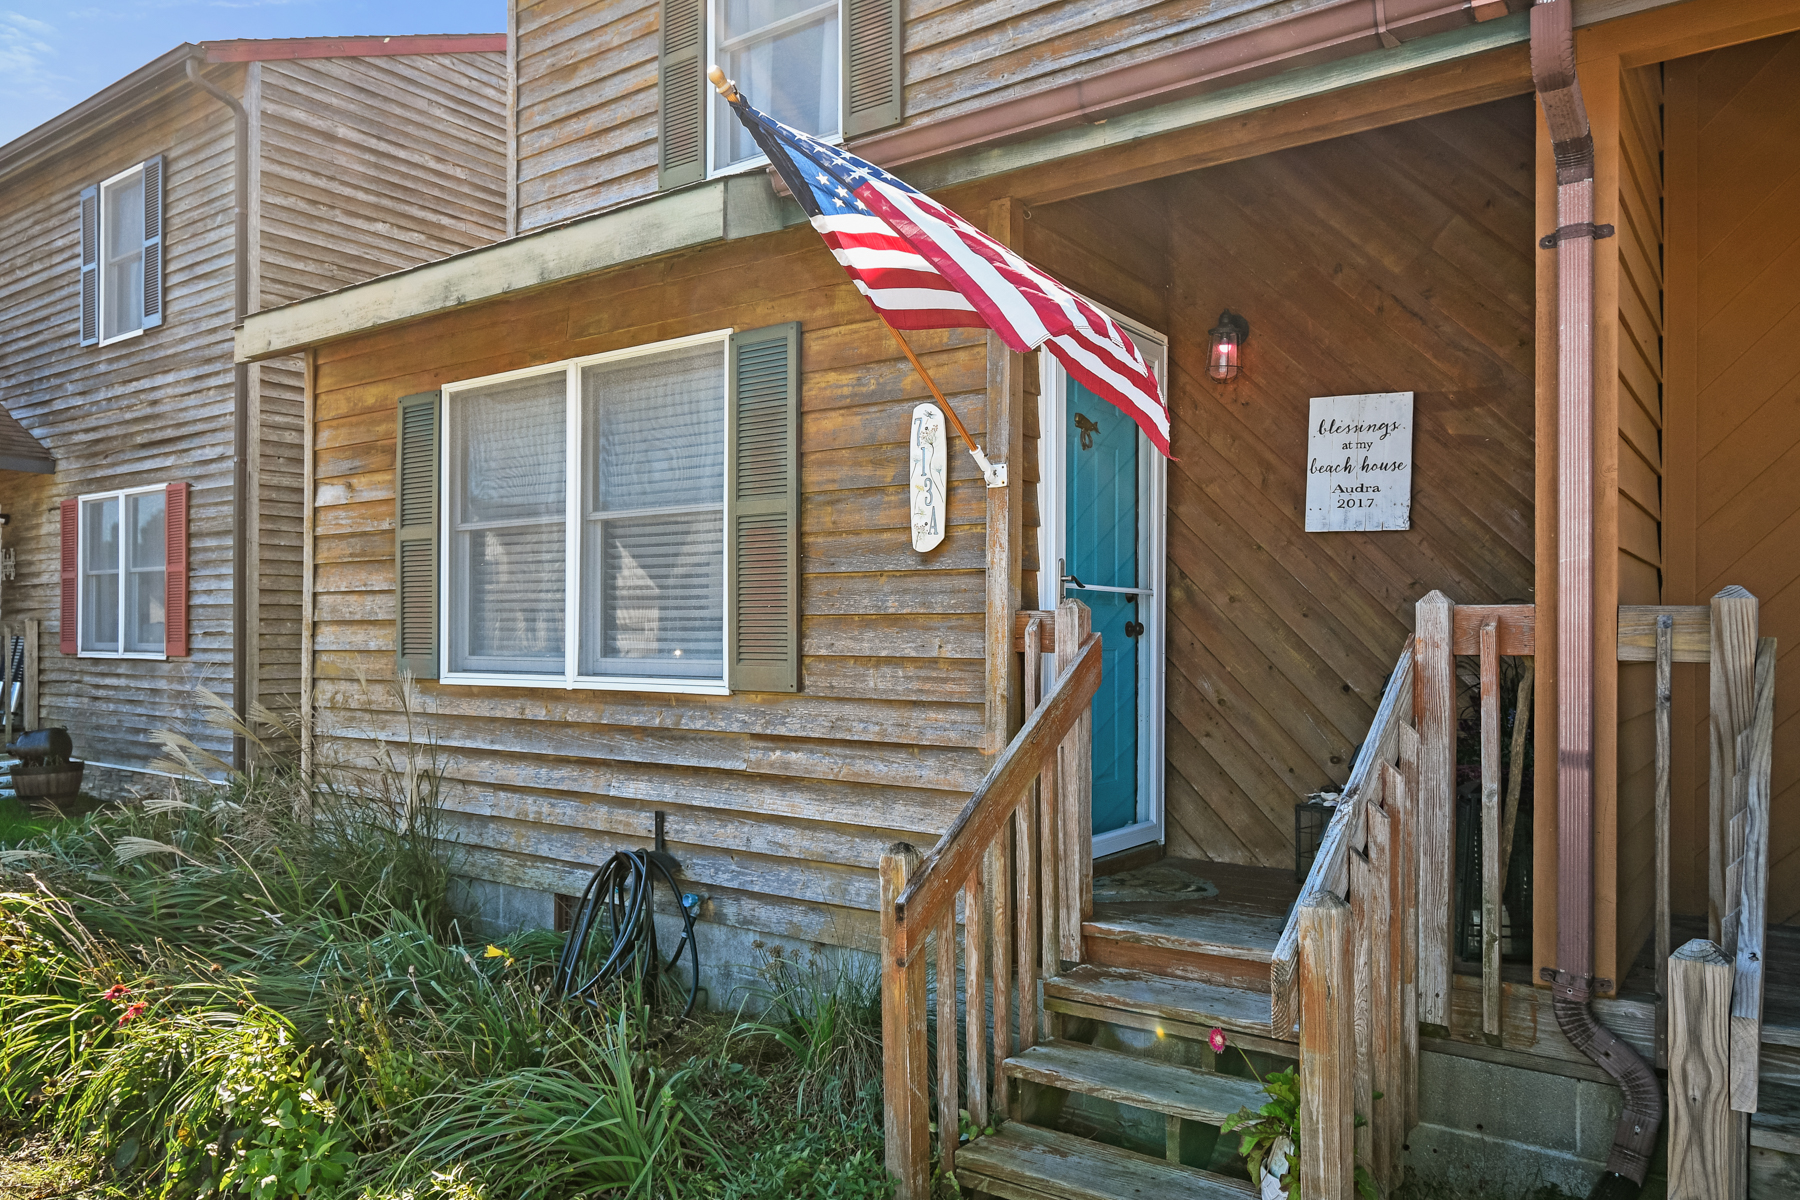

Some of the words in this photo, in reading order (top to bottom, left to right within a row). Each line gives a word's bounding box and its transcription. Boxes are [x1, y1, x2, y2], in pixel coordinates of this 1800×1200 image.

[1318, 419, 1401, 440] blessings
[1342, 441, 1353, 450] at
[1355, 441, 1373, 452] my
[1309, 456, 1356, 474] beach
[1360, 455, 1407, 473] house
[913, 417, 939, 535] 713A
[1332, 483, 1381, 494] Audra
[1337, 498, 1375, 509] 2017
